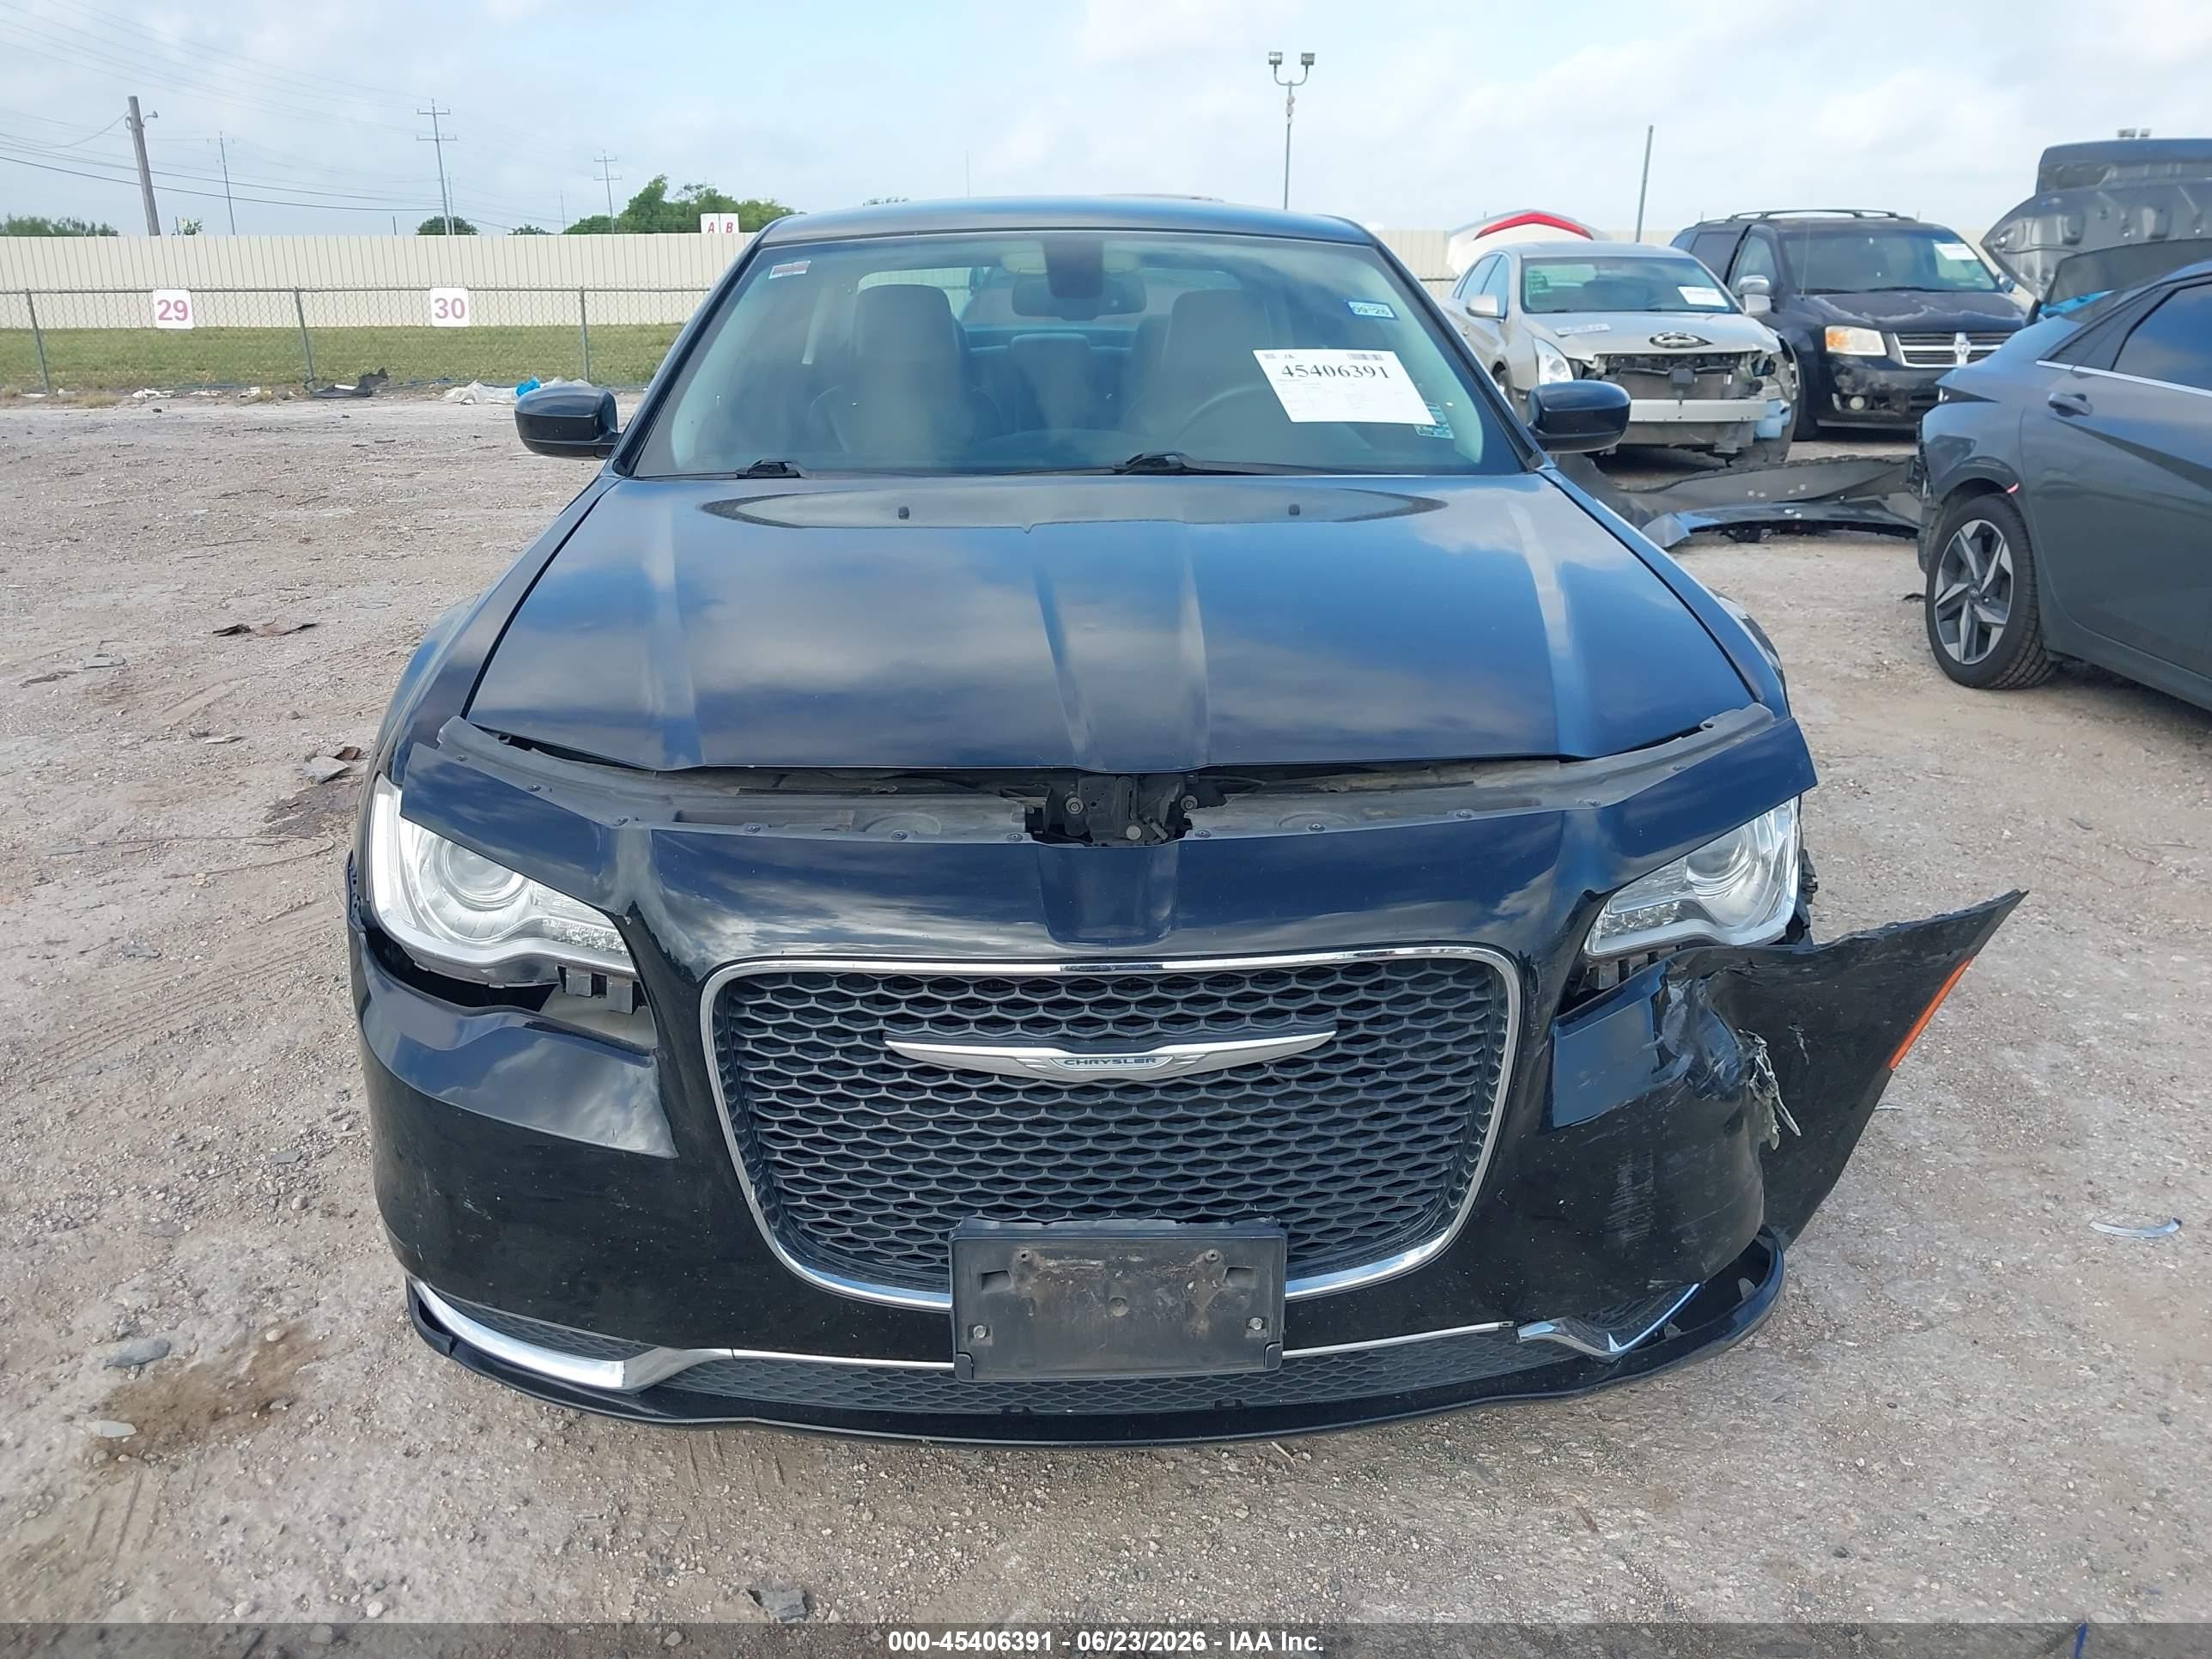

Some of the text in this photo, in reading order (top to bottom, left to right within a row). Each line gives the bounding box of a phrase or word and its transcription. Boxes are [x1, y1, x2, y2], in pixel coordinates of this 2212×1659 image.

[708, 222, 714, 233] A
[726, 222, 733, 233] B
[157, 299, 188, 321] 29
[434, 297, 465, 319] 30
[1281, 364, 1390, 379] 45406391
[1064, 1057, 1157, 1066] CHRYSLER
